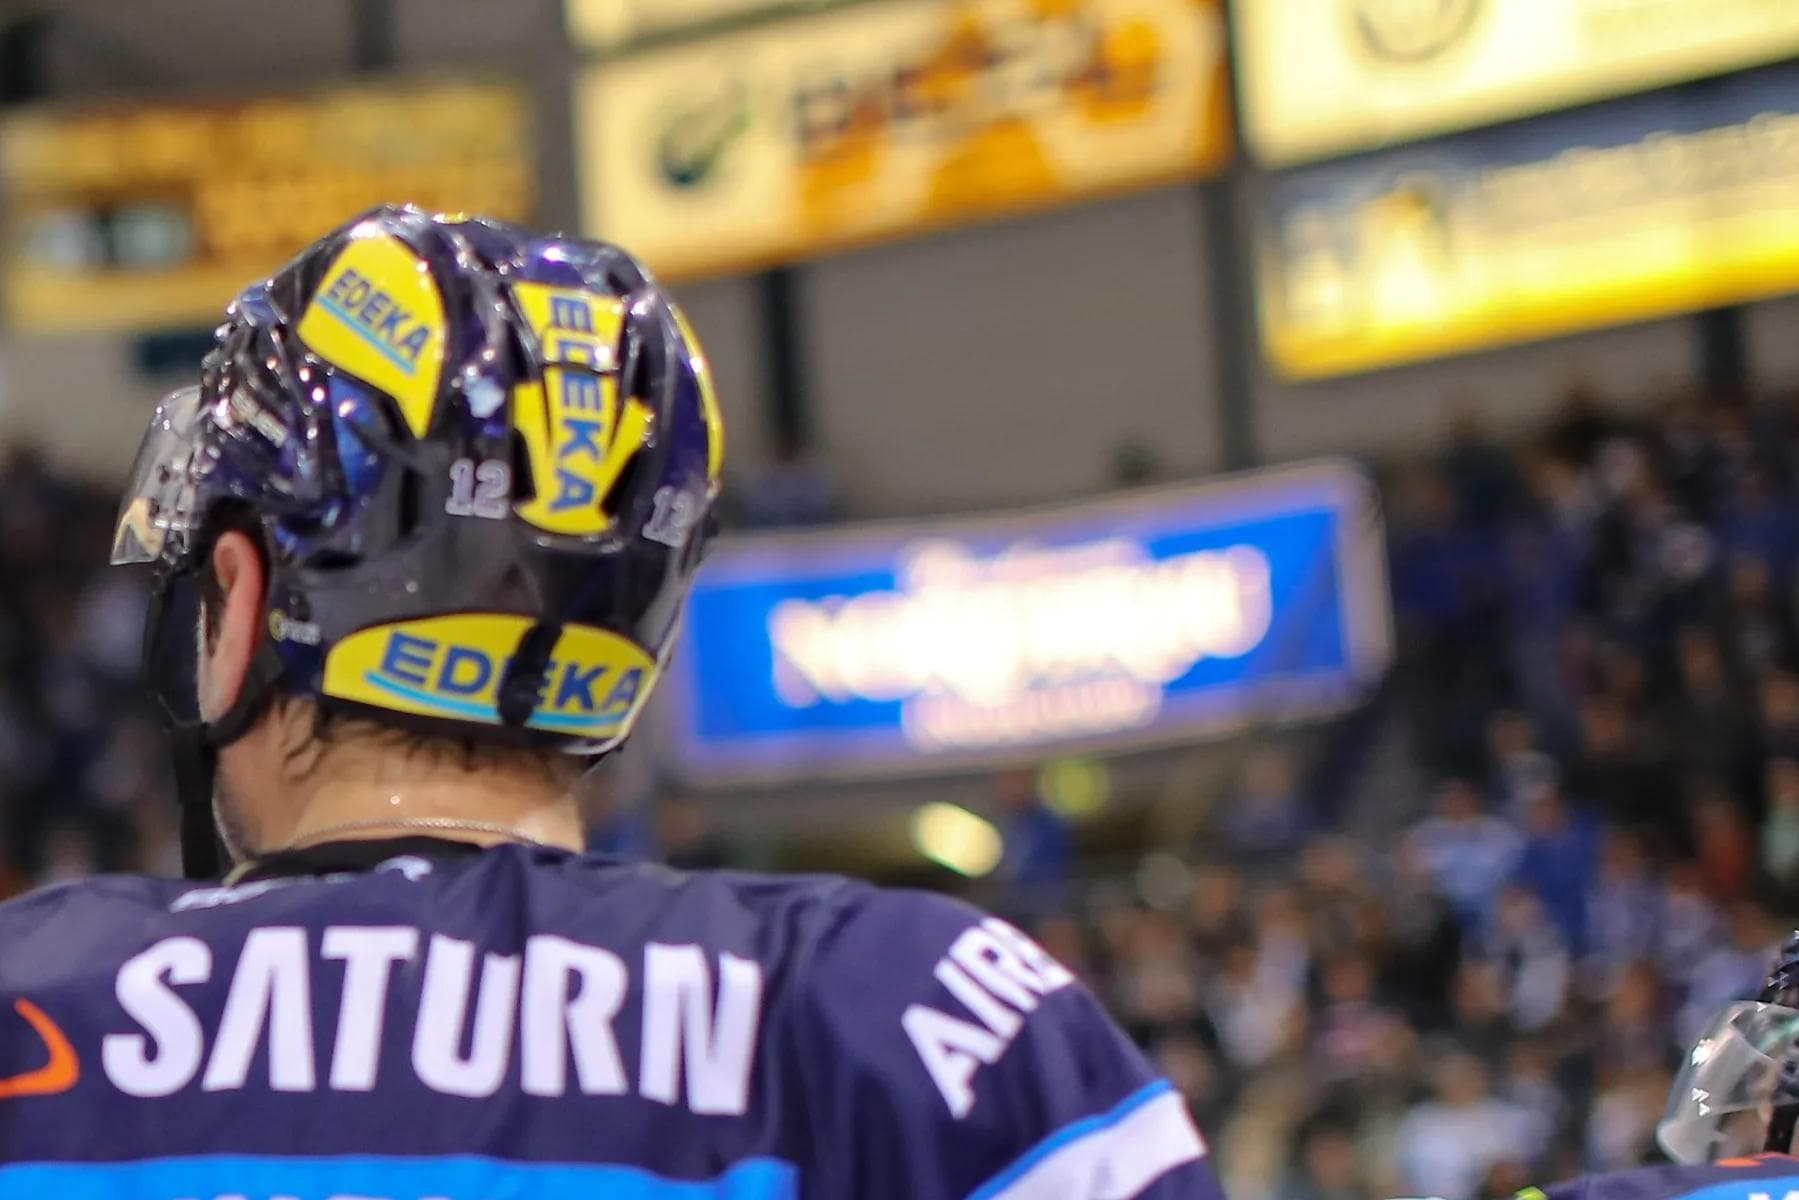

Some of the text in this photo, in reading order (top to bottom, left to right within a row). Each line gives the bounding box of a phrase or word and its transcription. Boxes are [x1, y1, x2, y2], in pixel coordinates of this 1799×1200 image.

[328, 268, 430, 360] EDEKA
[445, 457, 512, 520] 12
[382, 631, 644, 712] EDKA
[102, 925, 762, 1116] SATURN
